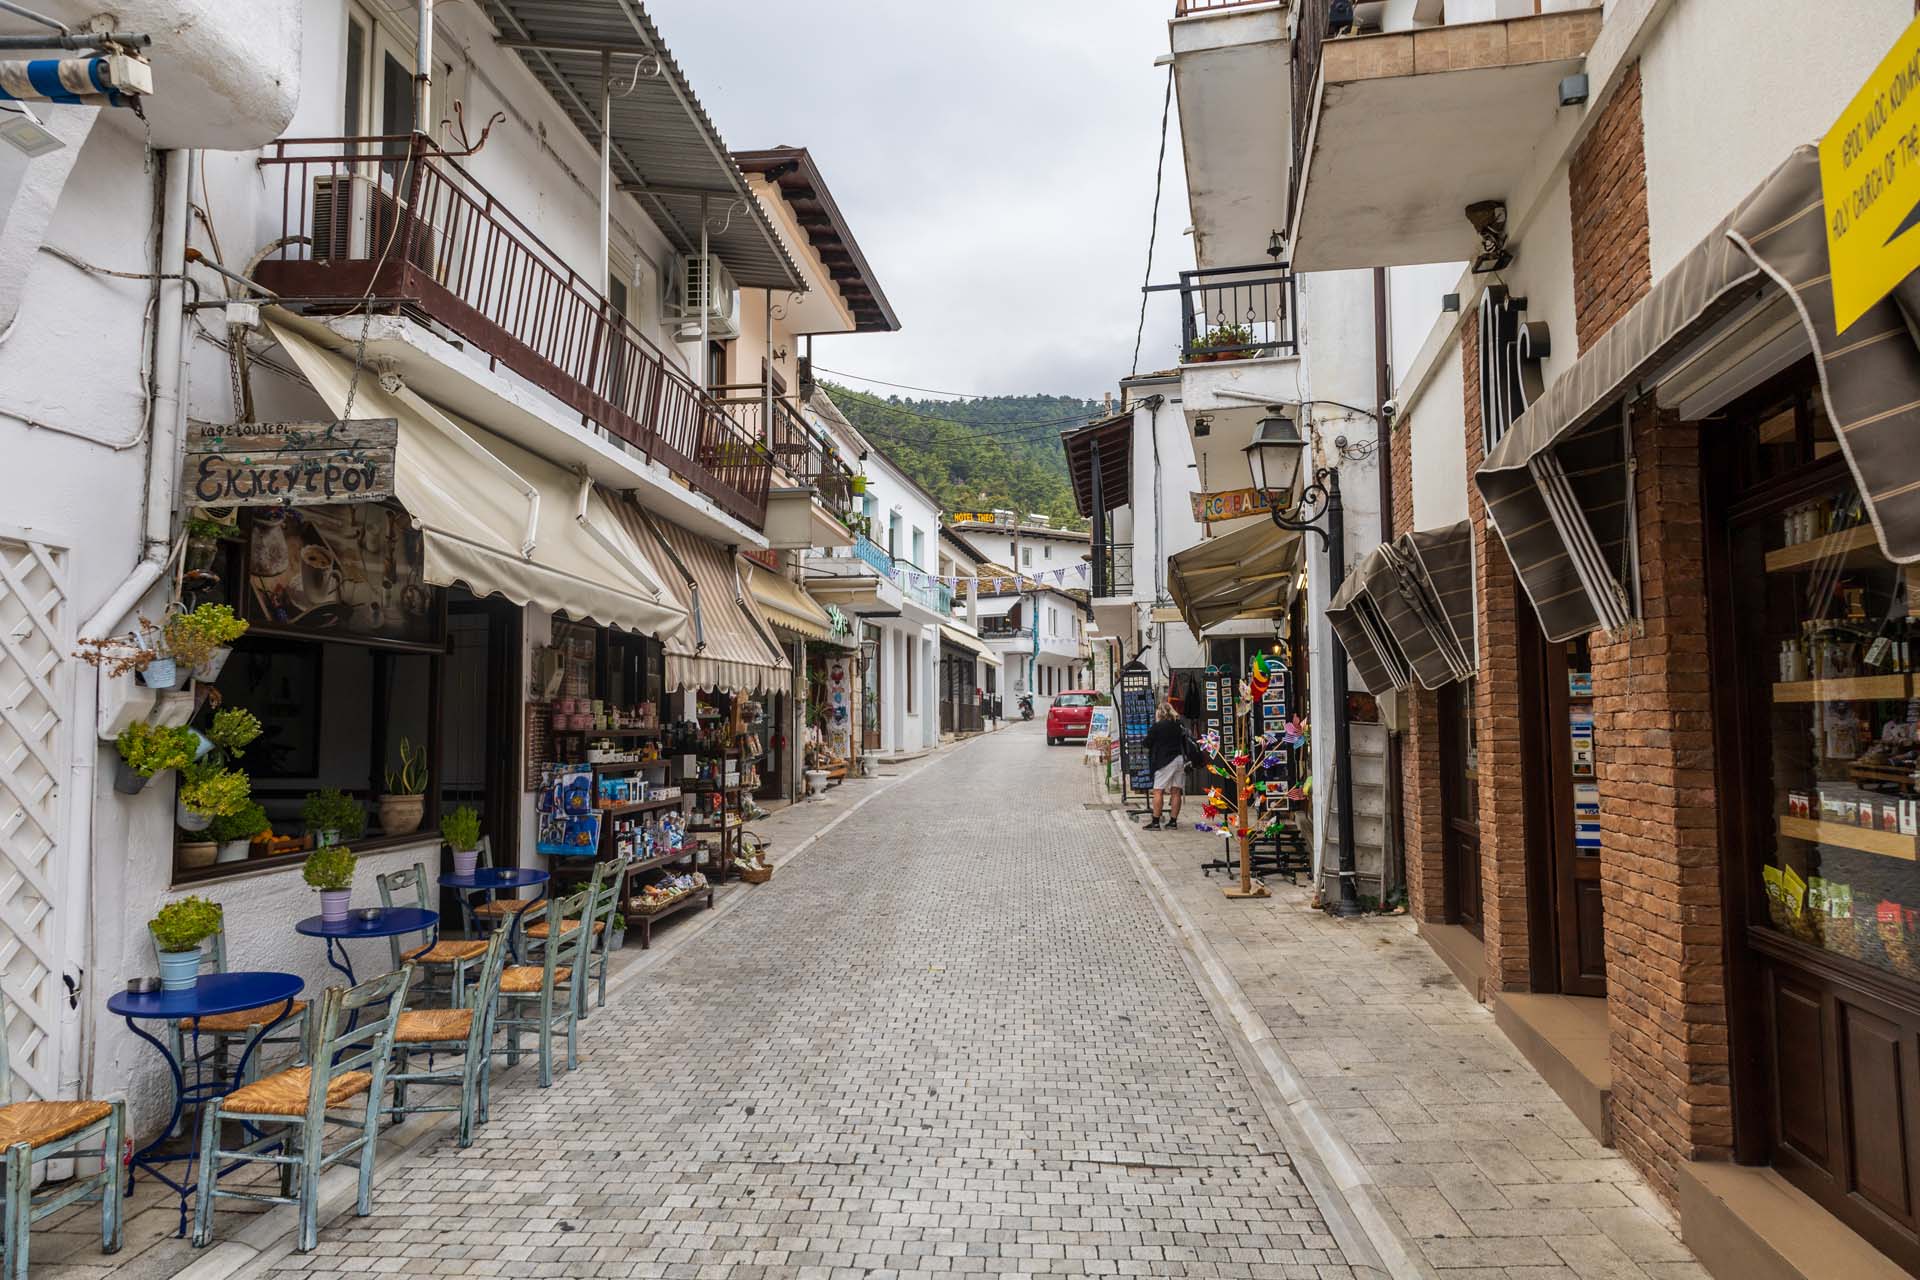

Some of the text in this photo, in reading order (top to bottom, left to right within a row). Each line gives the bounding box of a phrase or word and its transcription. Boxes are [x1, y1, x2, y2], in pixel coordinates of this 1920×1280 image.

[1832, 195, 1851, 241] HOLY
[1852, 165, 1885, 220] CHURCH
[1884, 148, 1897, 186] OF
[954, 512, 994, 523] HOTEL THEO
